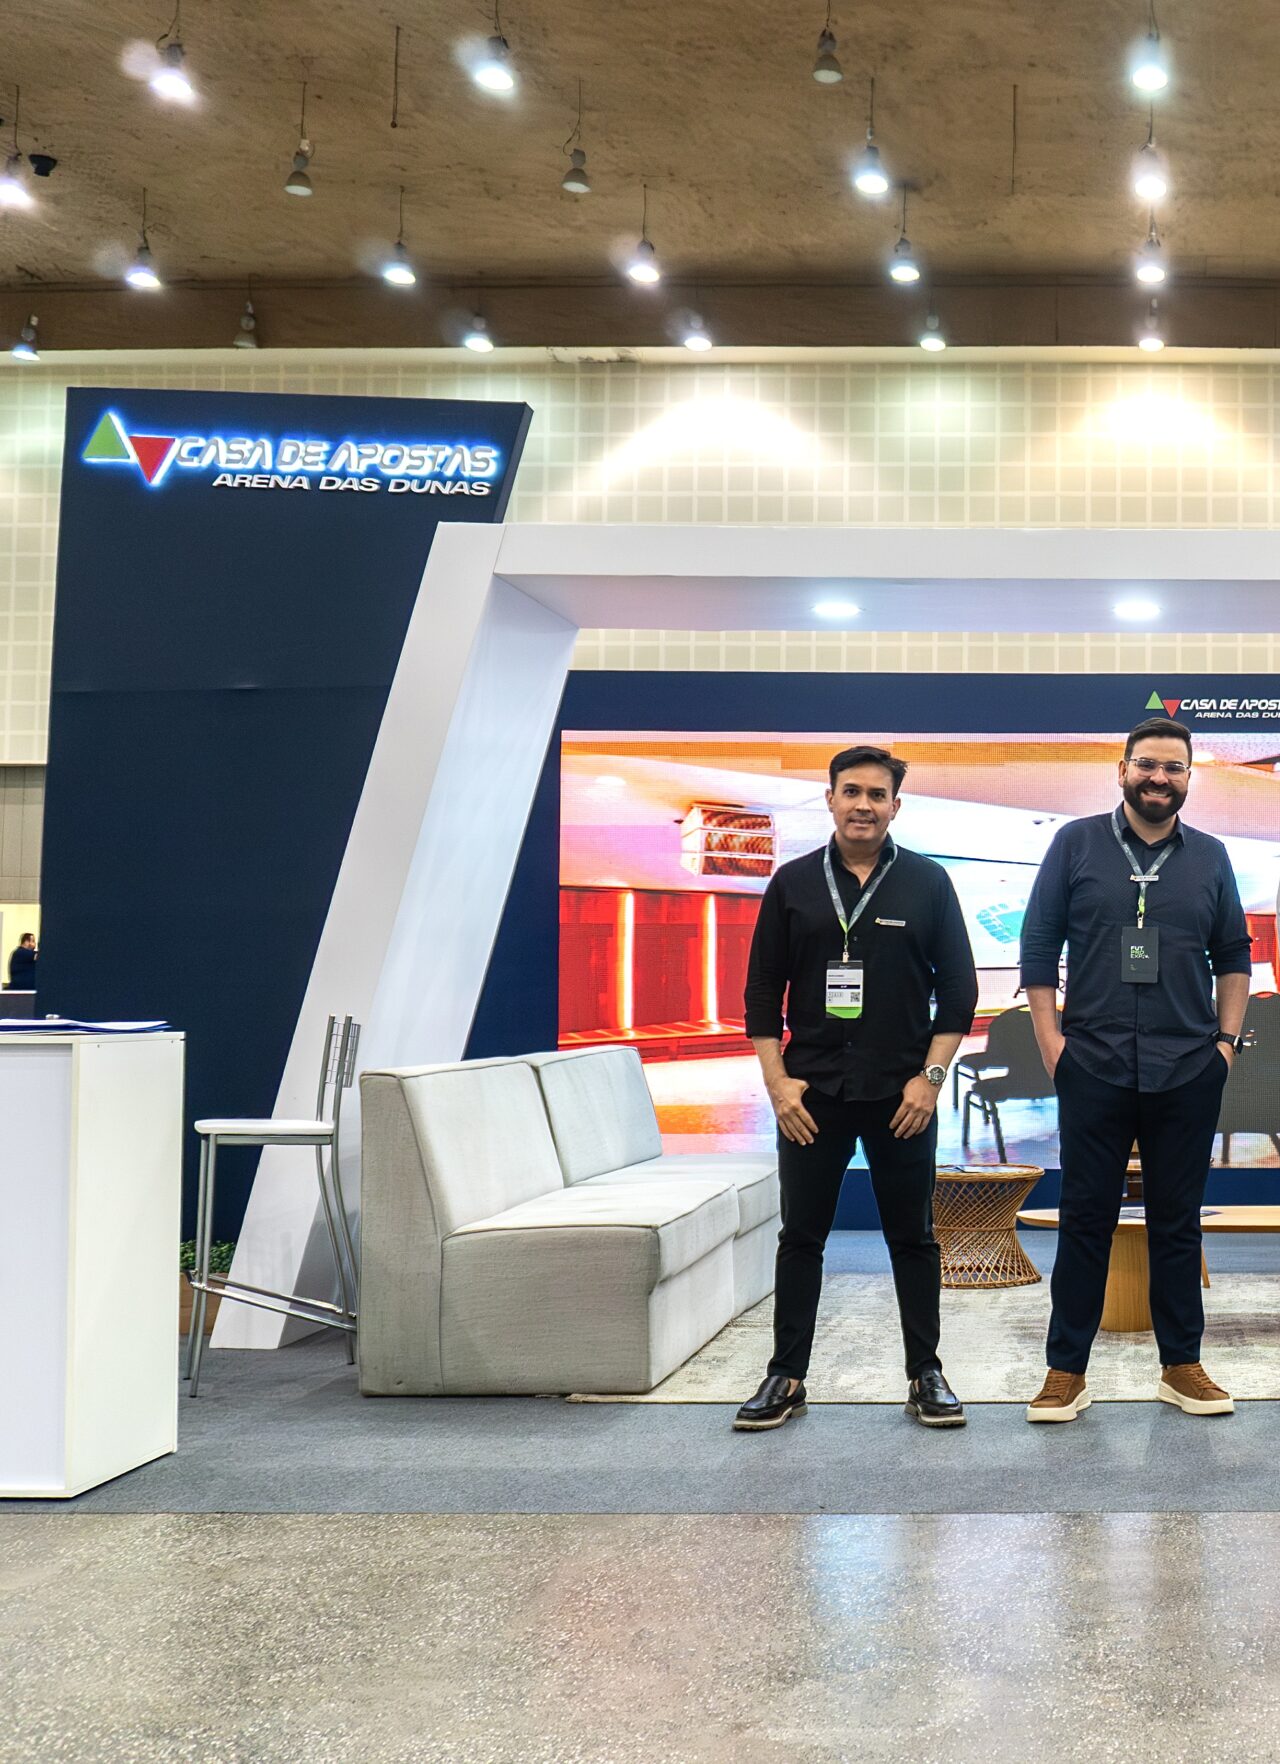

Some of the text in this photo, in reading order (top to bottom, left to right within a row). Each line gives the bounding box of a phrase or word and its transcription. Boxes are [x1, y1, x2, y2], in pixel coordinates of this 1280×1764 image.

[176, 437, 497, 477] CASA DE APOSTAS
[212, 473, 493, 496] ARENA DAS DUNAS
[1180, 699, 1217, 710] CASA
[1219, 699, 1239, 710] DE
[1194, 711, 1232, 719] ARENA
[1235, 711, 1259, 719] DAS
